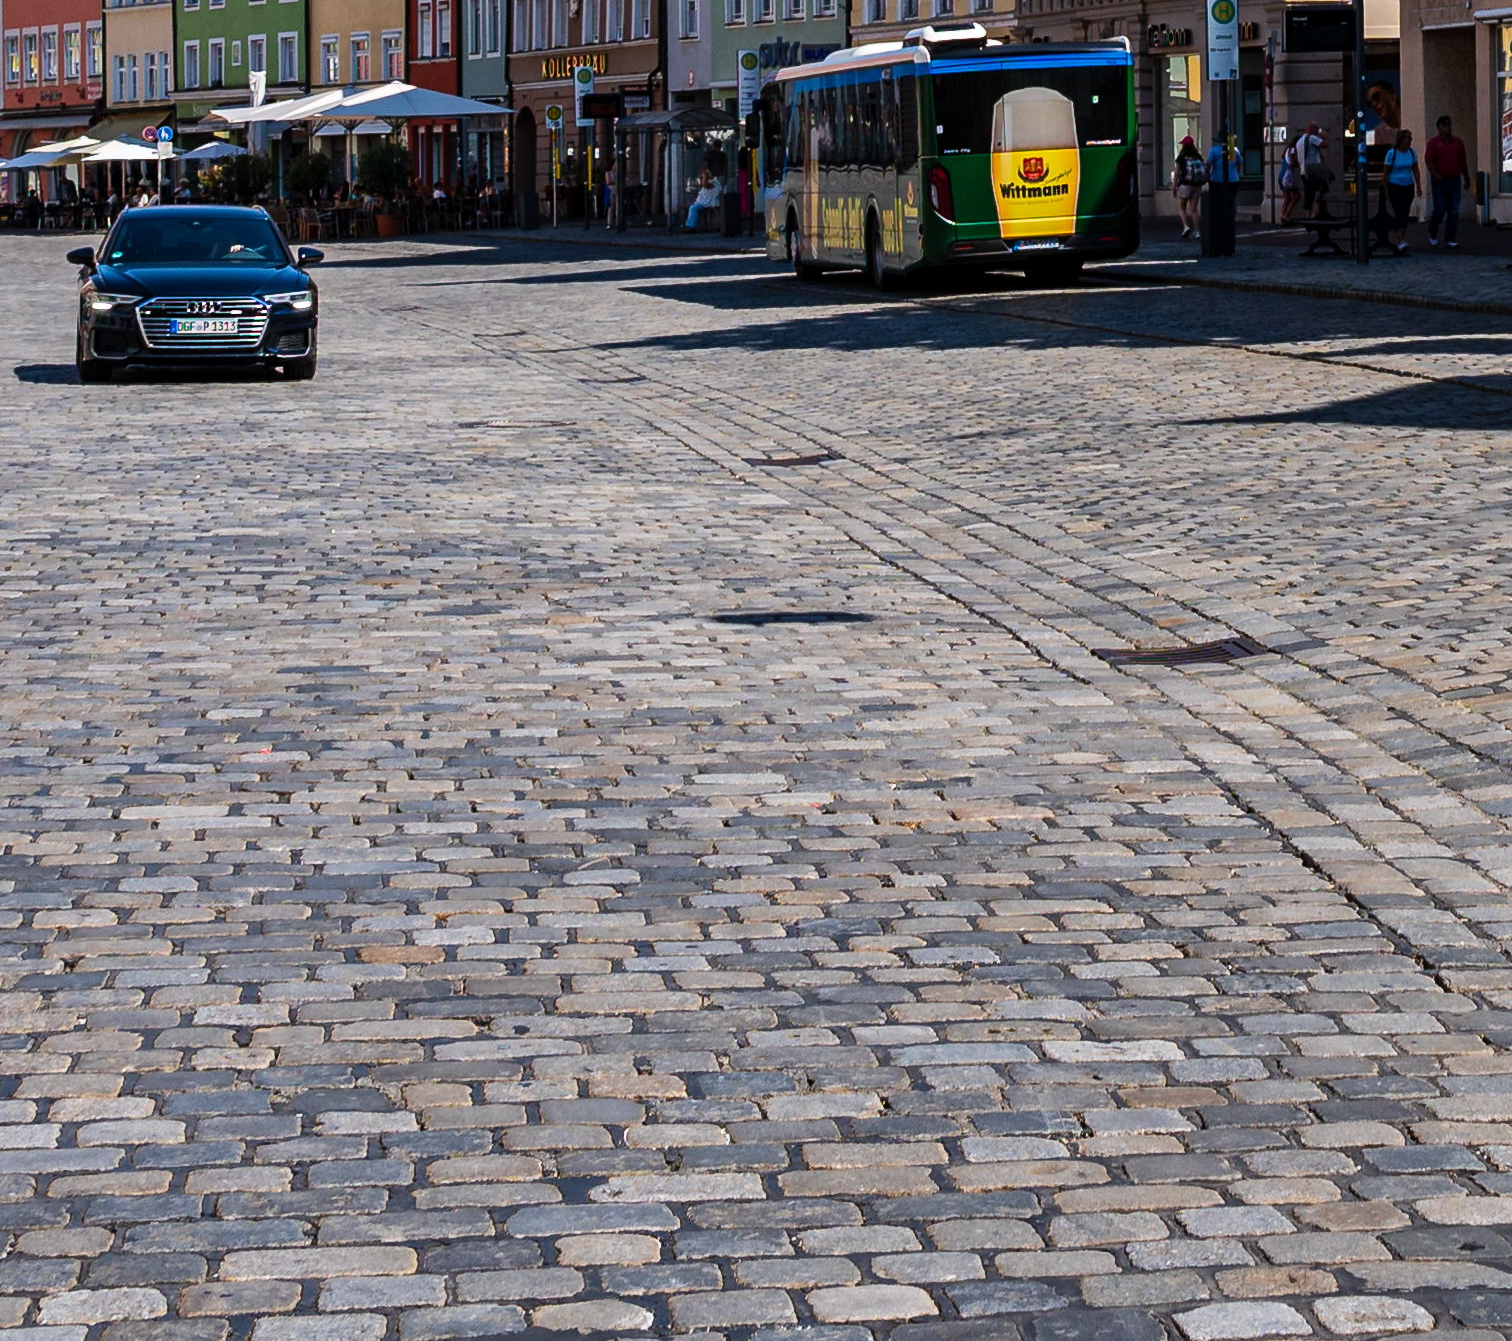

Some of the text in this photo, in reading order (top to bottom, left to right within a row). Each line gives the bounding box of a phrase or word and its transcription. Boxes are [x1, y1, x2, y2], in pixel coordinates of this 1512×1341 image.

[1000, 182, 1069, 199] Wittmann
[178, 321, 196, 331] DGF
[211, 321, 236, 331] 1313
